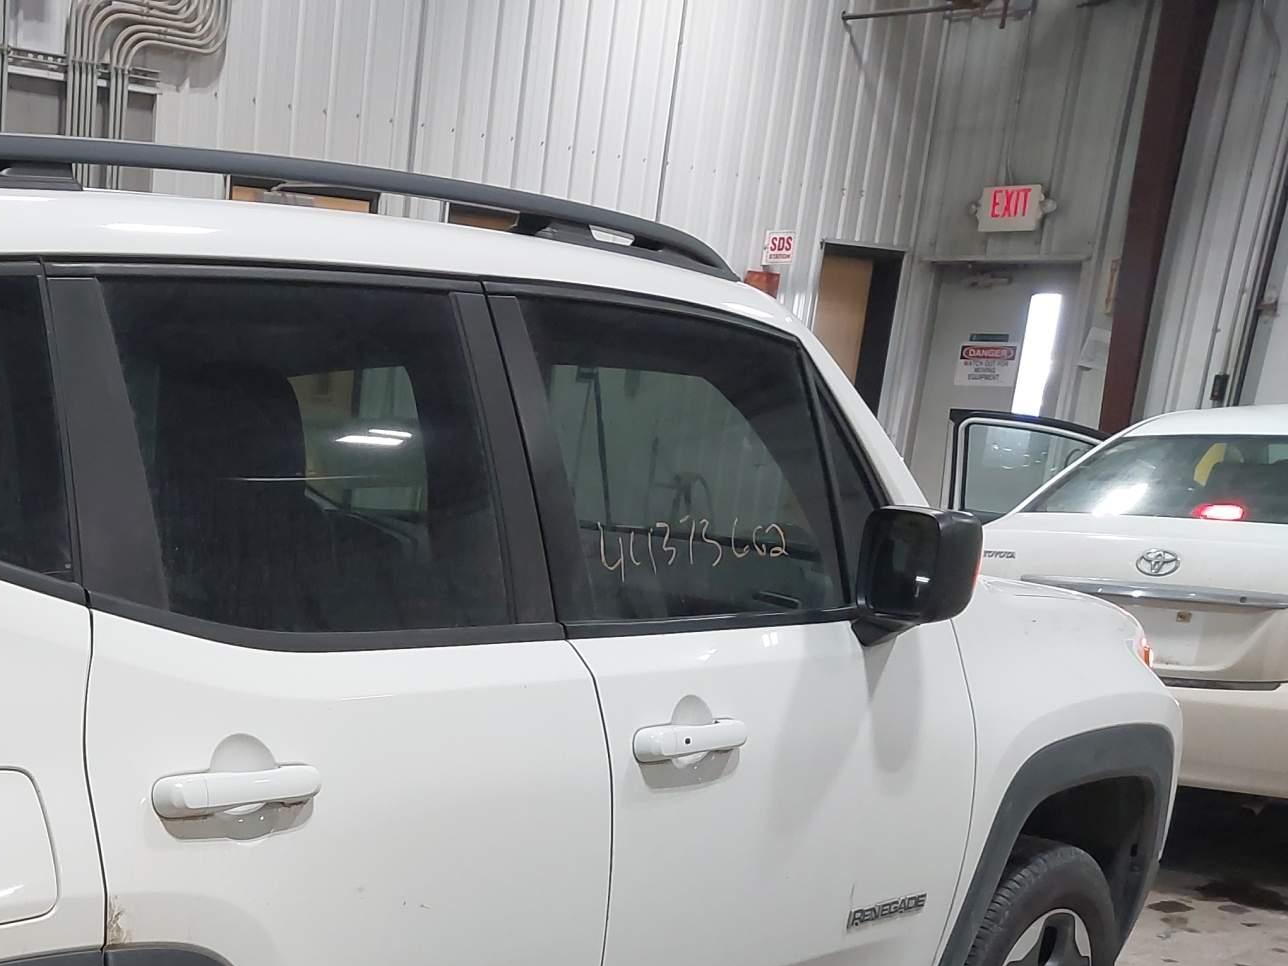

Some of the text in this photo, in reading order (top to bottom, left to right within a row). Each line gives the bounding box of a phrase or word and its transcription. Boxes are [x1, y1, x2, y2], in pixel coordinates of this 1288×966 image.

[991, 188, 1032, 217] EXIT
[770, 236, 793, 251] SDS
[968, 348, 1008, 358] DANGER
[846, 892, 928, 930] RENEGADE
